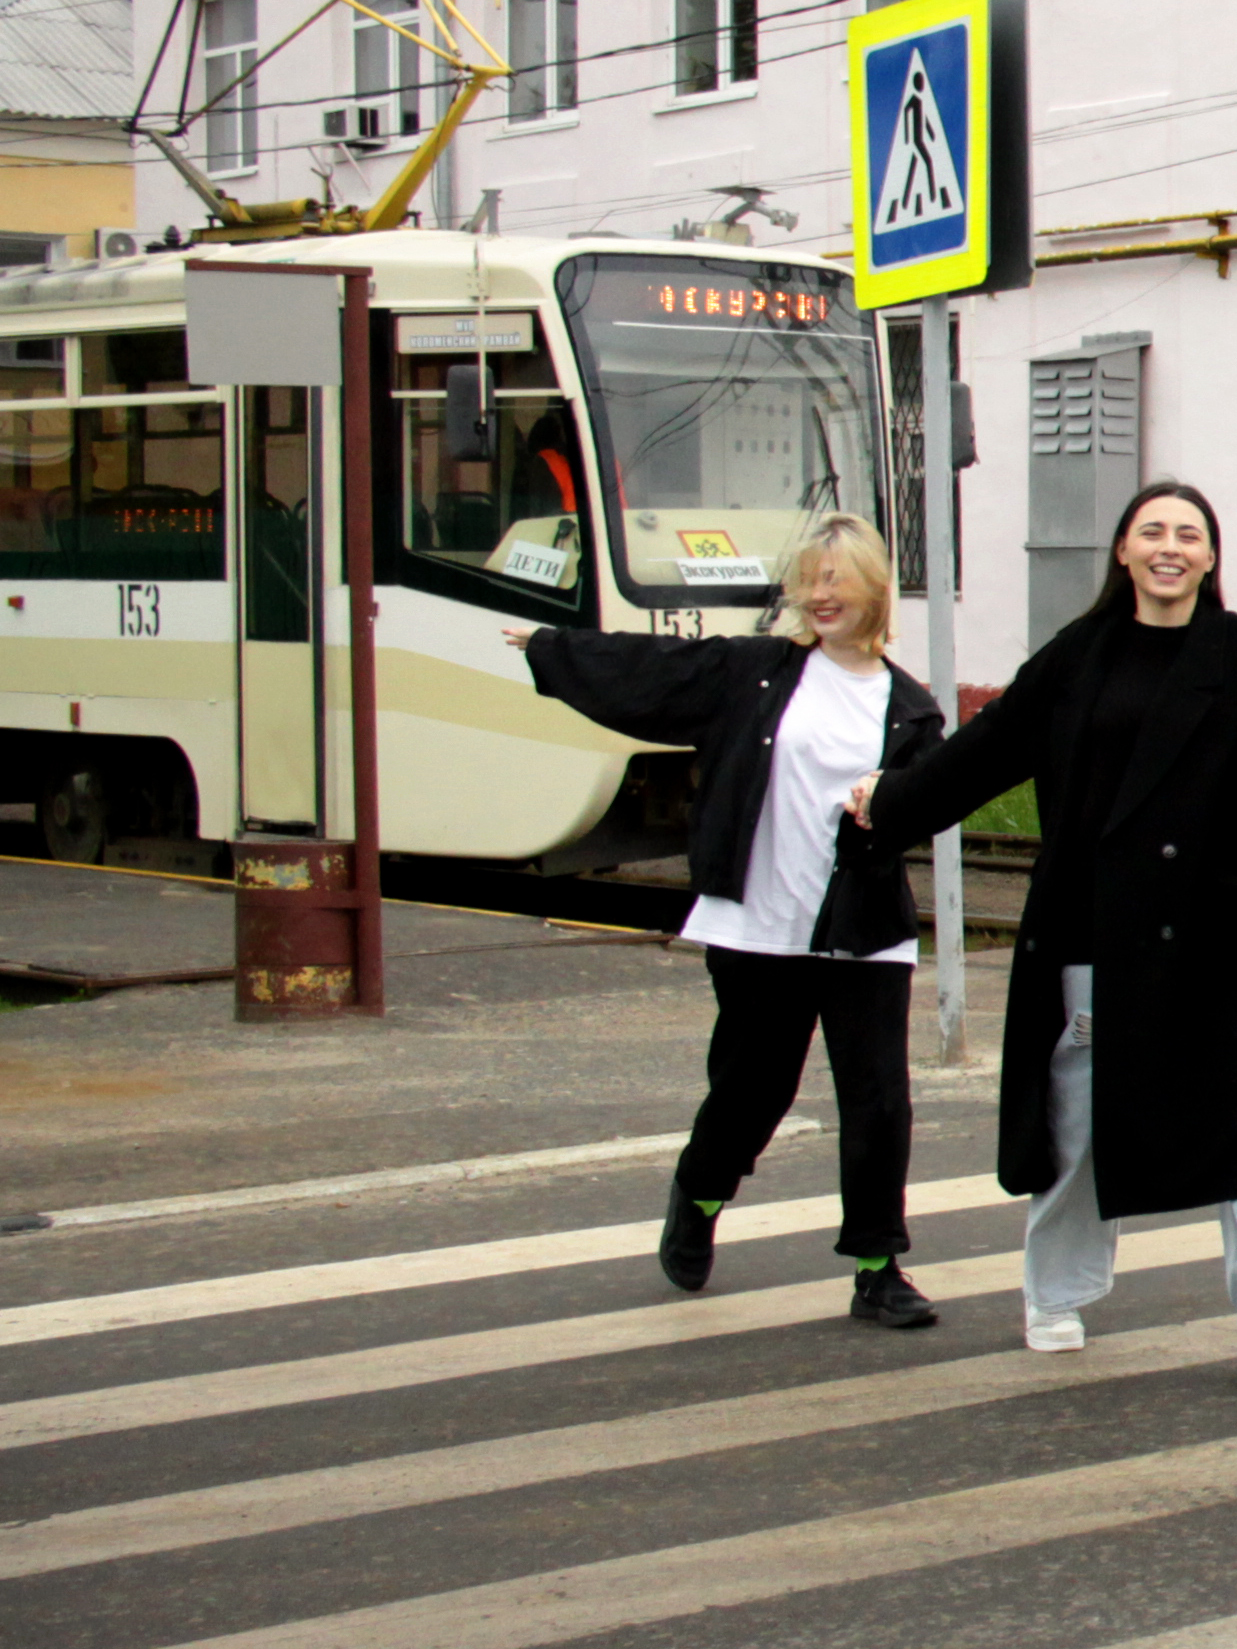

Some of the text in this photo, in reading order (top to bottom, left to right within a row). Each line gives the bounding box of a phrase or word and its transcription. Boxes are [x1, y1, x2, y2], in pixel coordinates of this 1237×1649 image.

[479, 331, 521, 347] РАМВАЙ
[506, 552, 560, 578] ДЕТИ
[117, 584, 160, 636] 153
[649, 609, 703, 640] 153
